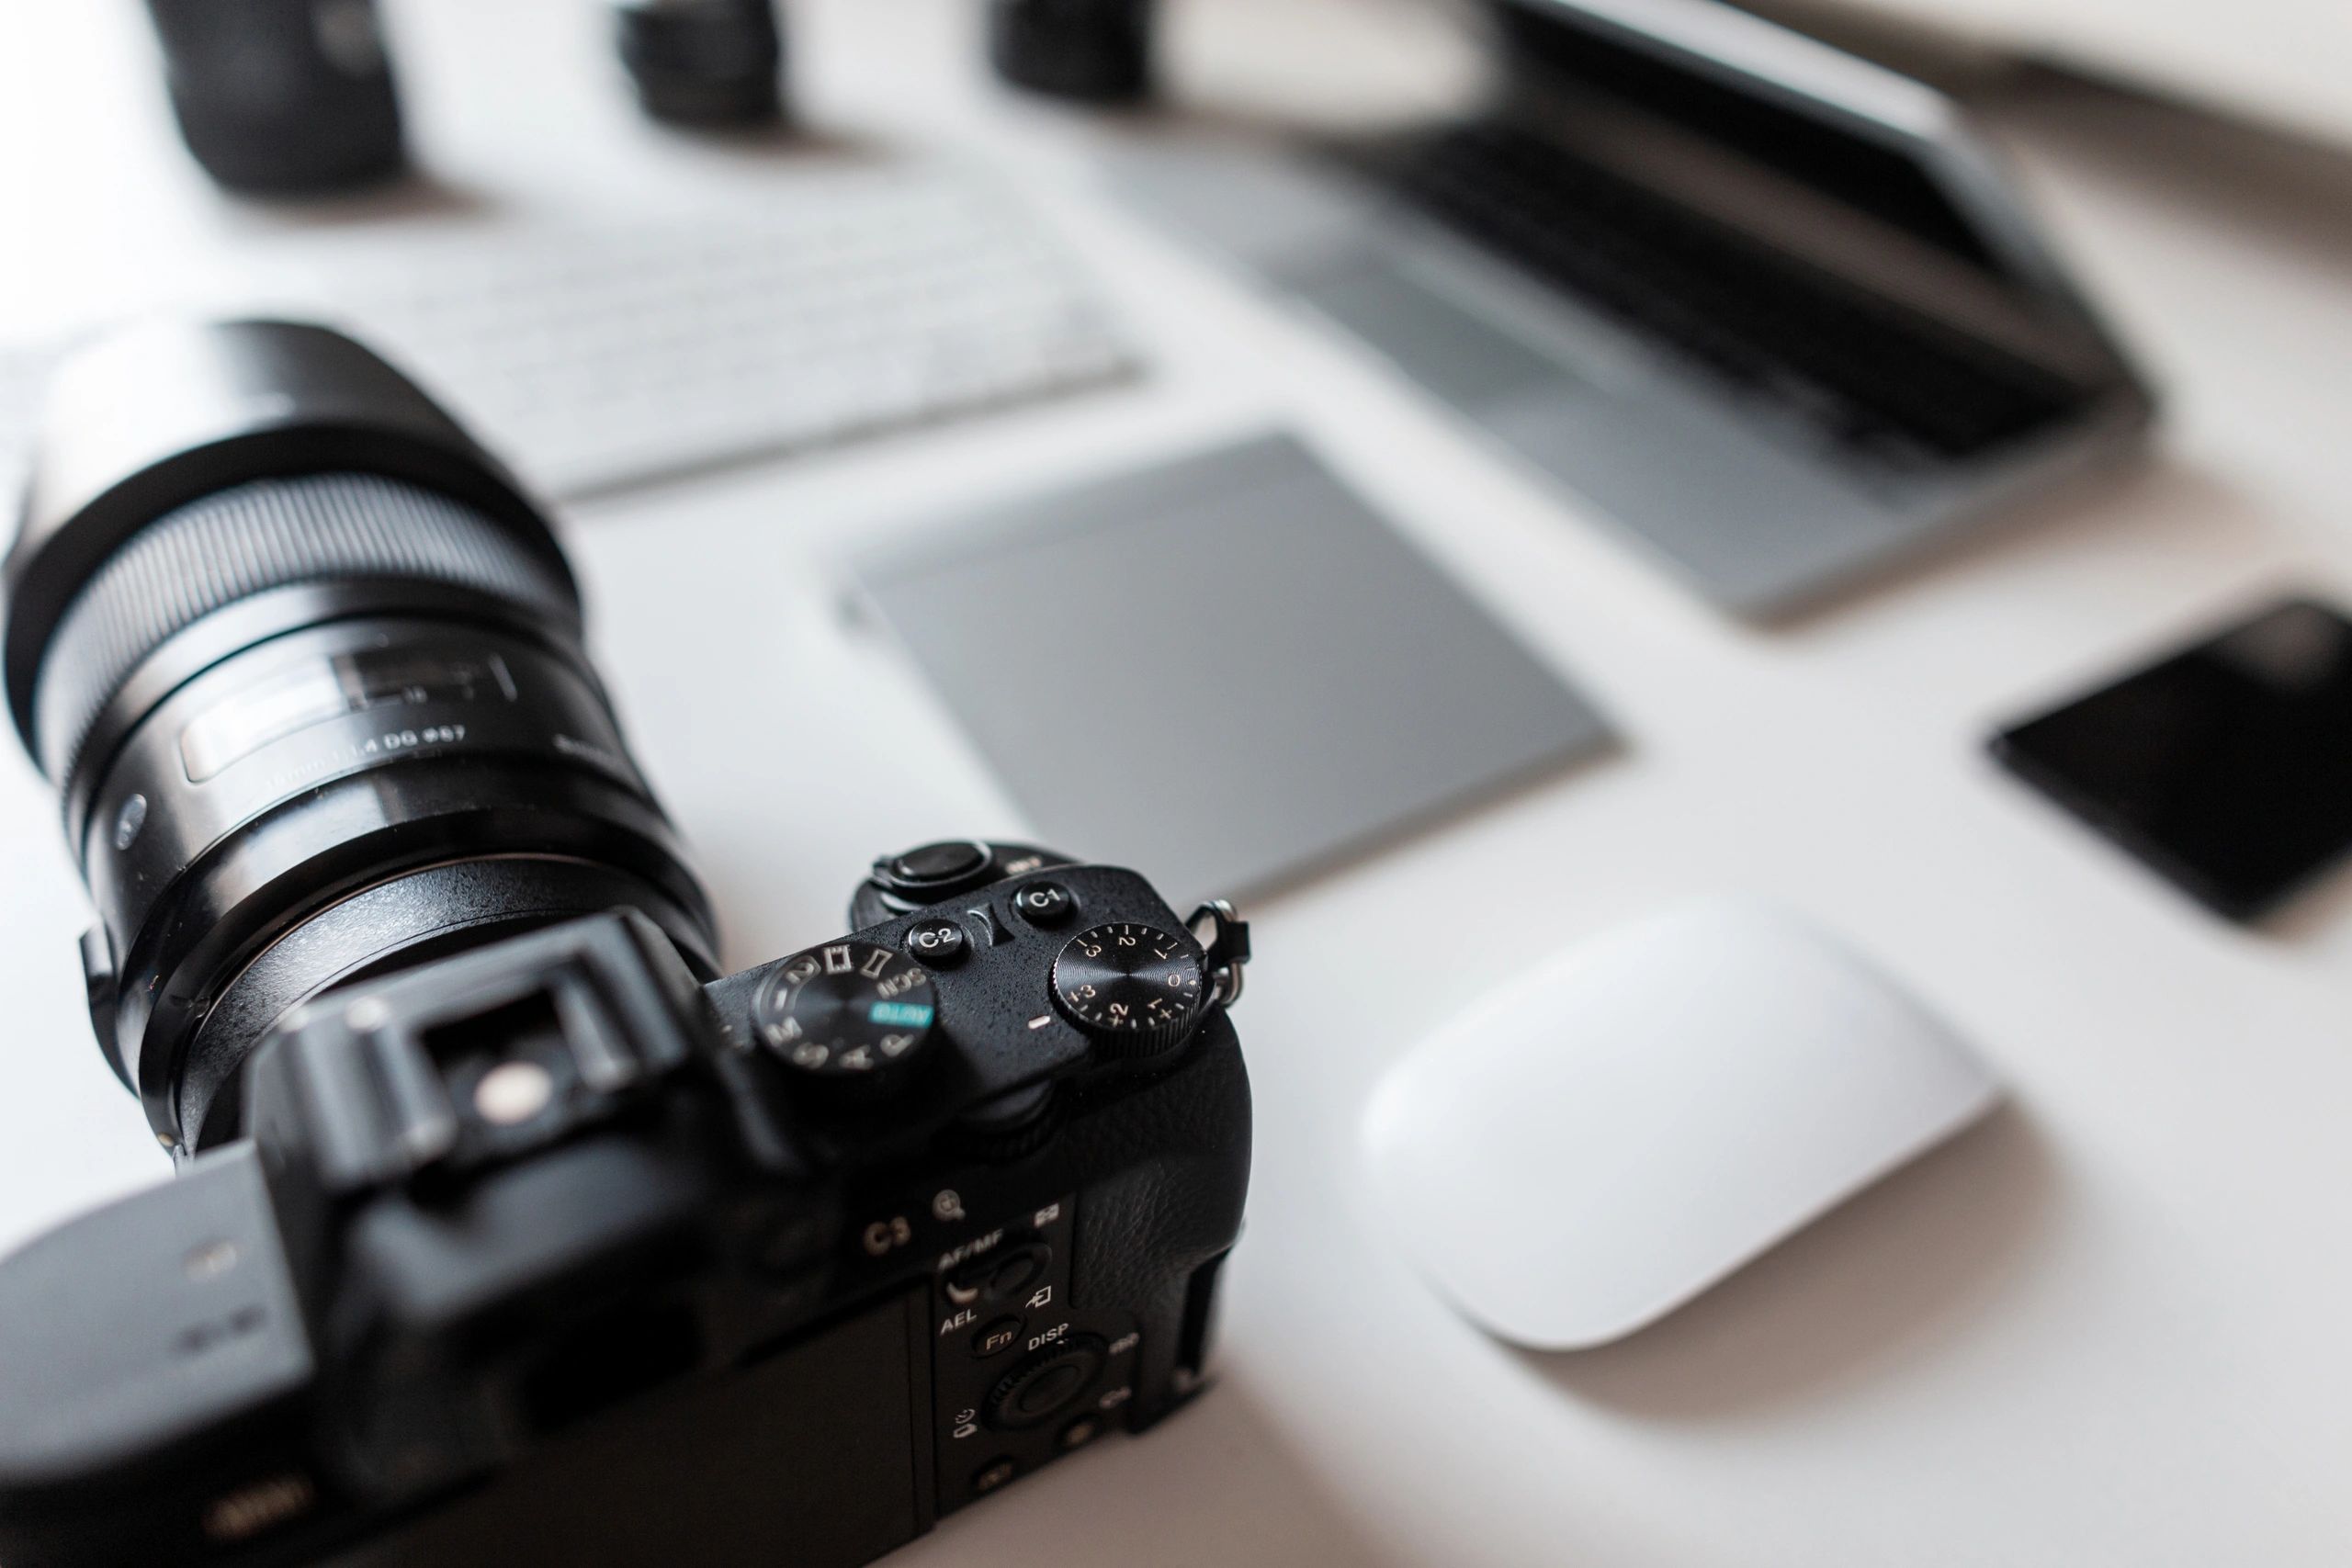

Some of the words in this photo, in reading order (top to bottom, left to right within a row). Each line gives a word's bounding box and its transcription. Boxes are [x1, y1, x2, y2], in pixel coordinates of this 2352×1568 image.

[1029, 888, 1060, 908] C1
[919, 928, 956, 948] C2
[1168, 974, 1181, 987] 0
[870, 1001, 933, 1028] AUTO
[864, 1216, 911, 1256] C3
[938, 1228, 1004, 1270] AF/MF
[940, 1309, 978, 1336] AEL
[986, 1331, 1012, 1351] Fn
[1027, 1323, 1070, 1351] DISP
